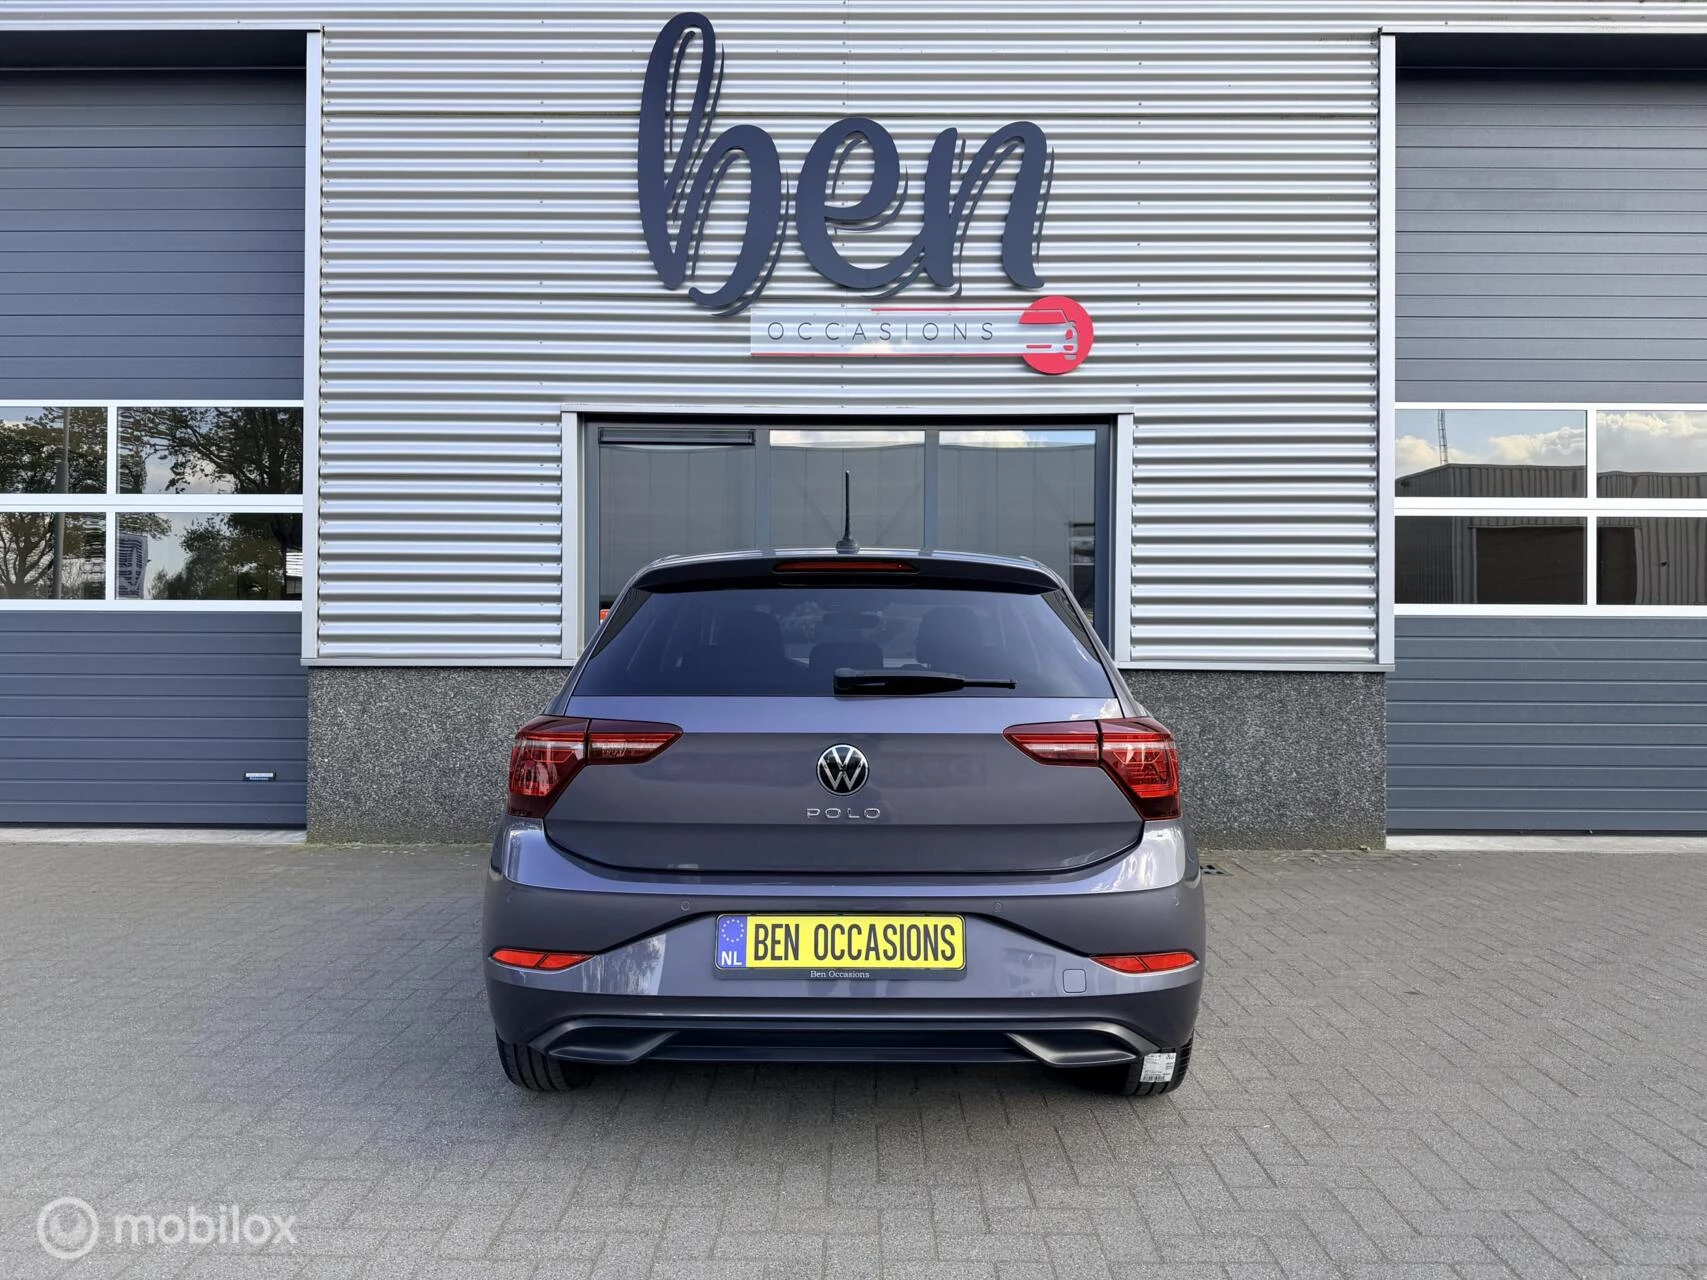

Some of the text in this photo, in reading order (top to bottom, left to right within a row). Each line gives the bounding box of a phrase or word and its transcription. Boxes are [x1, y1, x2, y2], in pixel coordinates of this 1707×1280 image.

[637, 11, 1053, 312] ben
[767, 321, 995, 341] OCCASIONS
[806, 807, 881, 819] POLO
[754, 923, 956, 961] BEN OCCASIONS
[721, 950, 743, 966] NL
[810, 970, 870, 978] Ben Occasions
